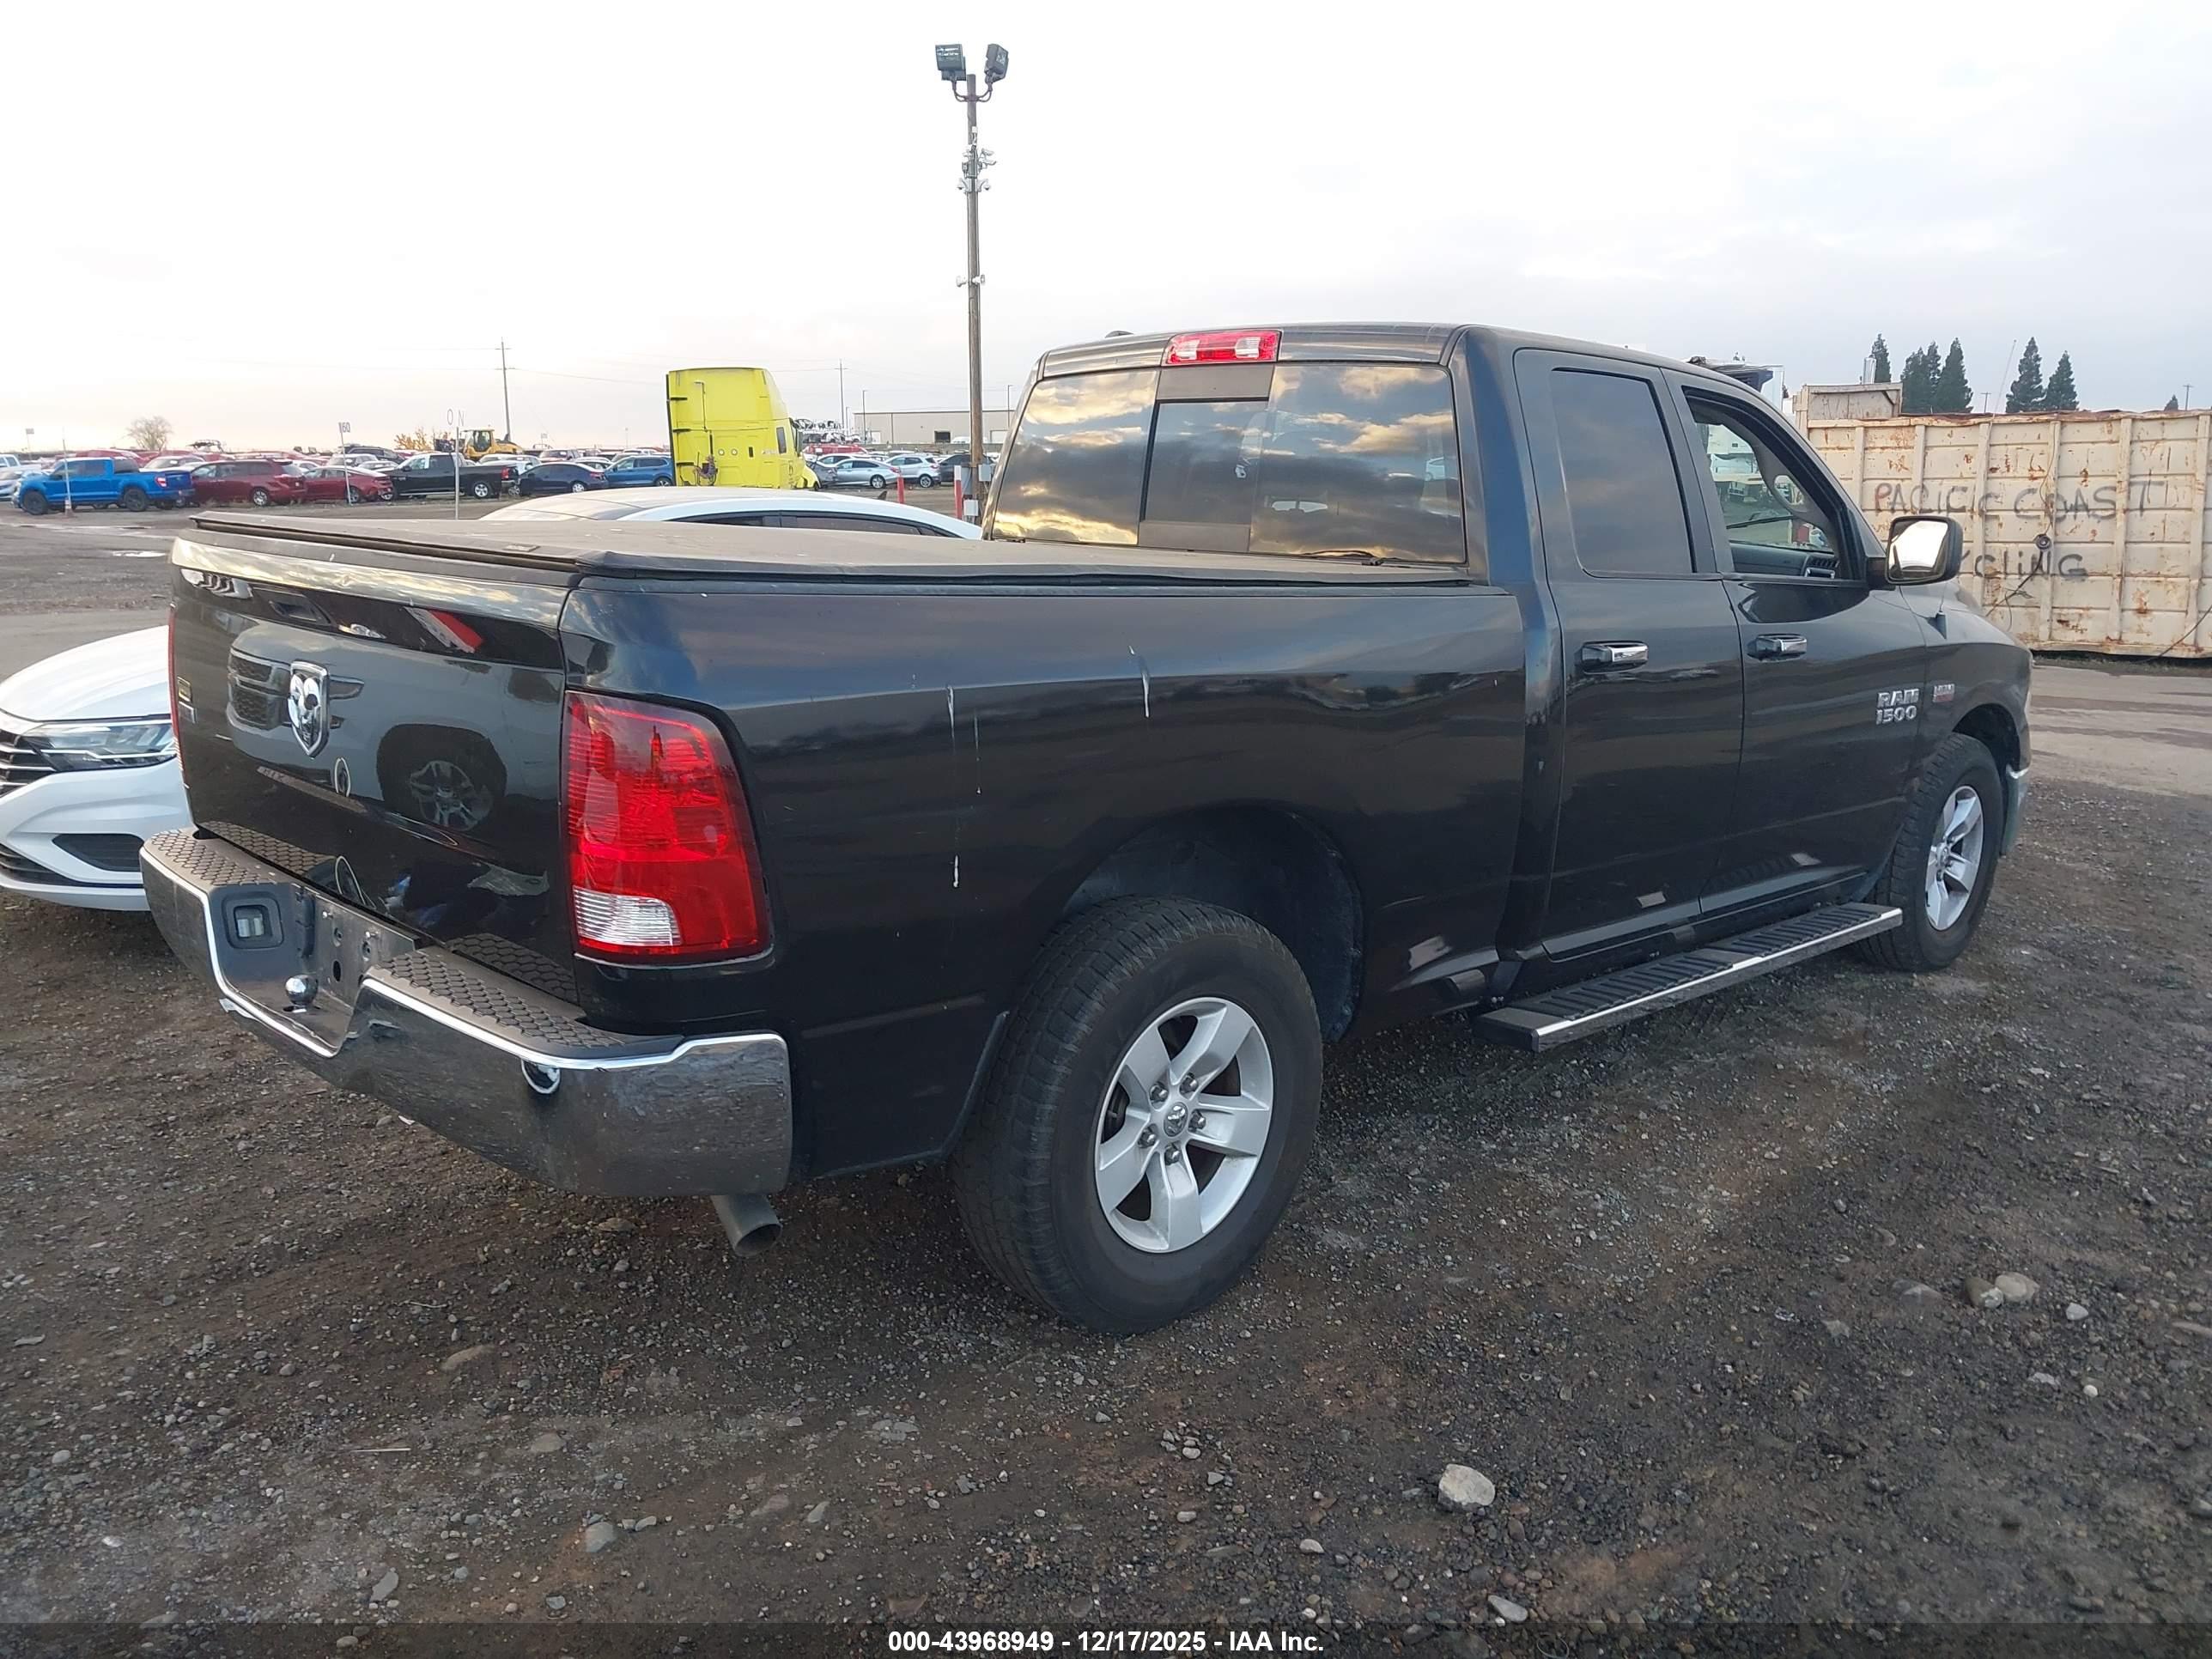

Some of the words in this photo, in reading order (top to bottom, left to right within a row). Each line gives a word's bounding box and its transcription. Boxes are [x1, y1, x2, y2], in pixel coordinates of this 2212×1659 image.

[2014, 481, 2165, 522] COAST
[1877, 688, 1919, 708] RAM
[1875, 705, 1917, 725] 1500
